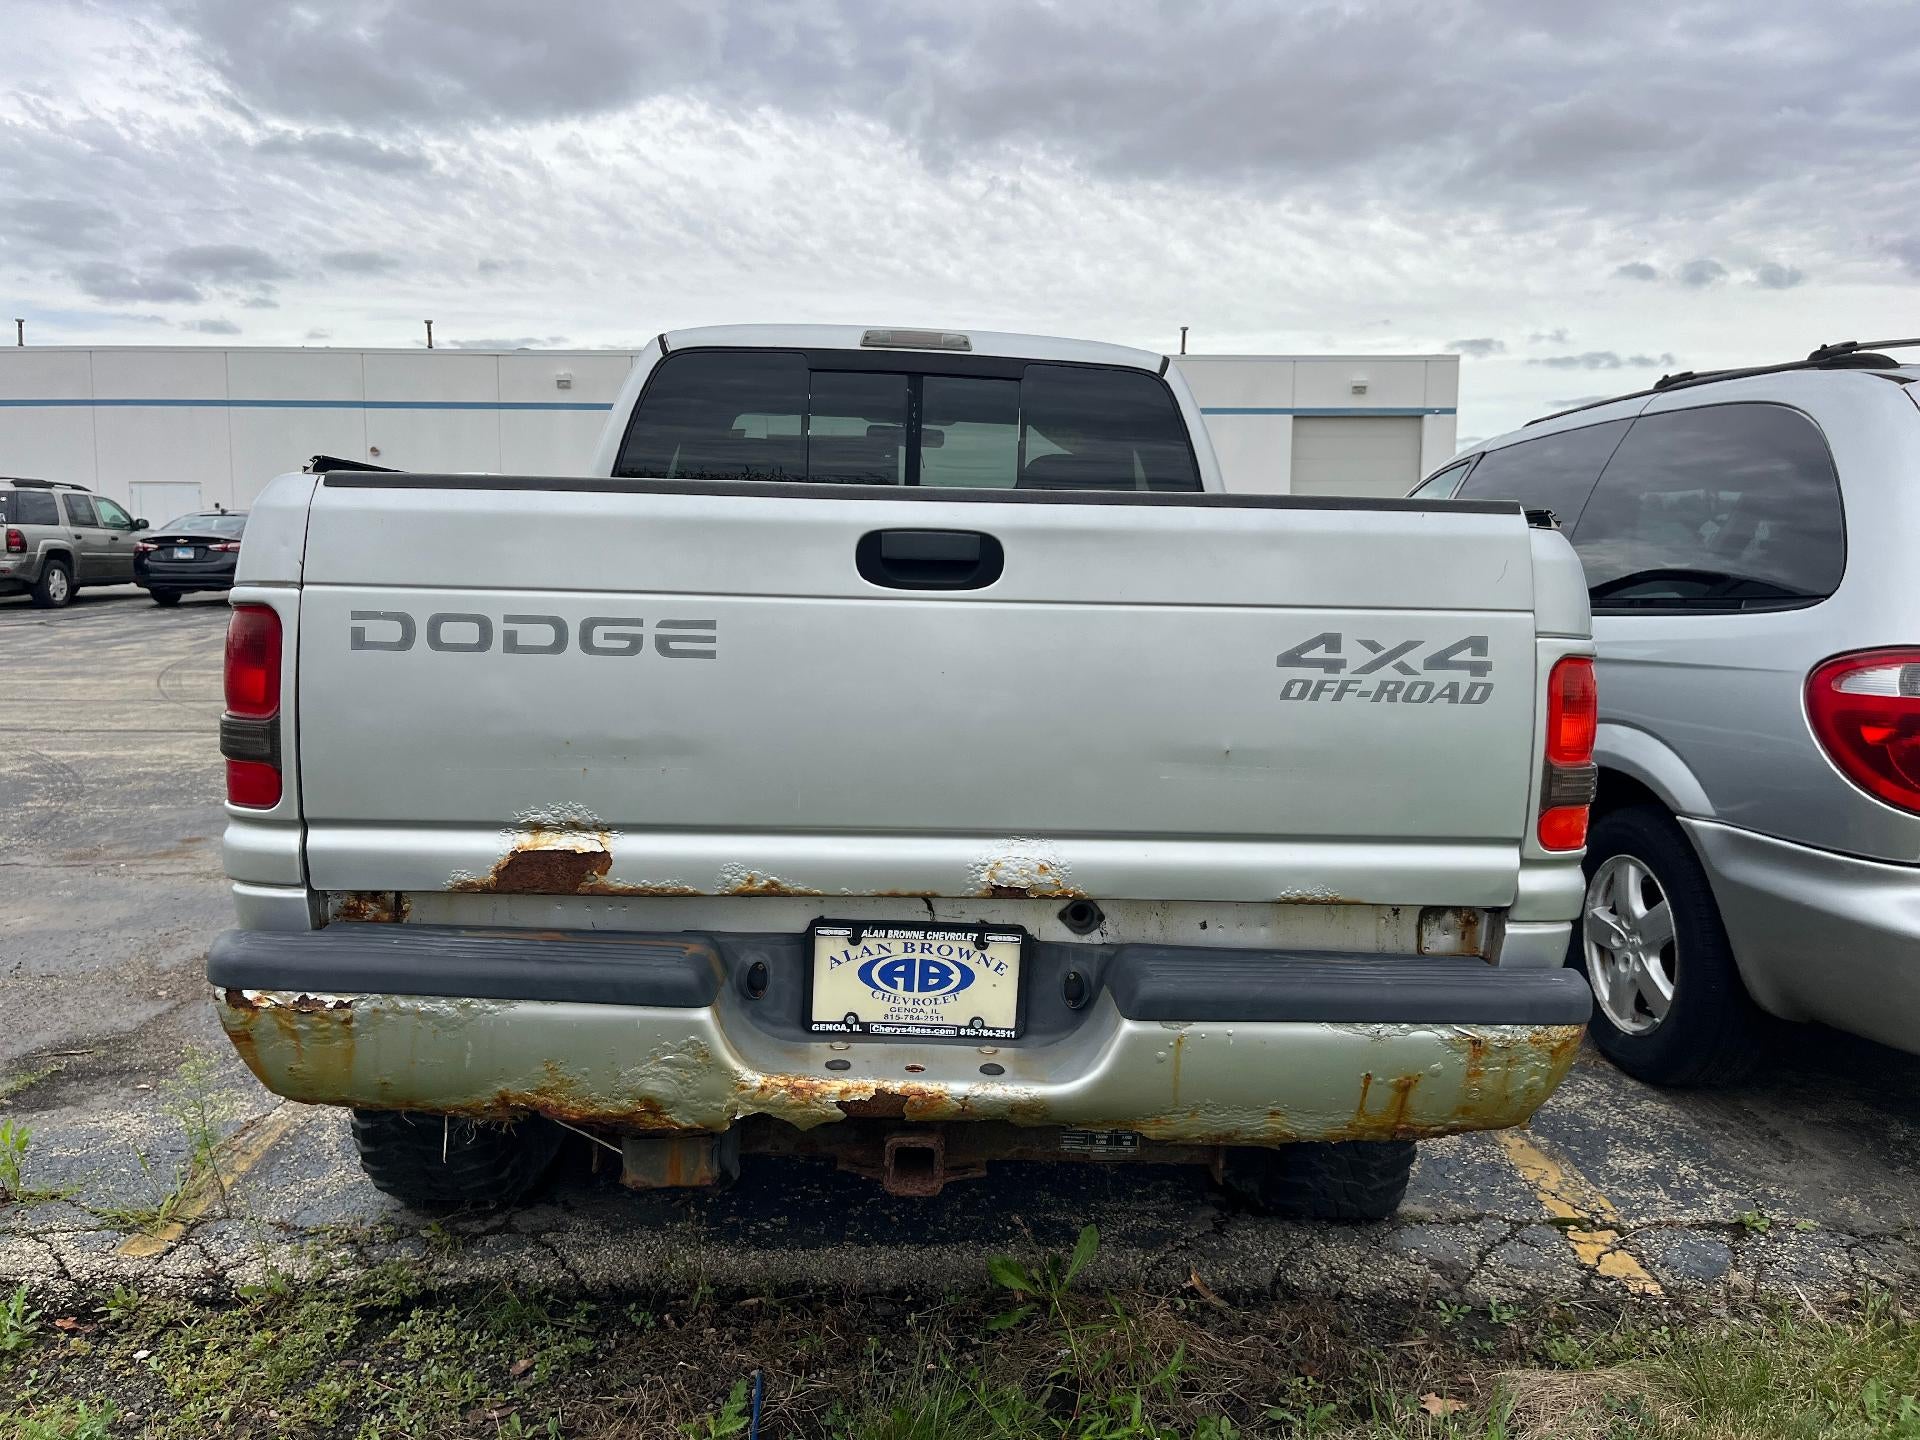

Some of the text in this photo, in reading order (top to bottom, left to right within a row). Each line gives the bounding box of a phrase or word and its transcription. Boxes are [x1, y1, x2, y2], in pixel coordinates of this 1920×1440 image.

[350, 610, 717, 660] DODGE
[1279, 678, 1495, 705] OFF-ROAD
[861, 928, 886, 939] ALAN
[887, 929, 925, 940] BROWNE
[926, 931, 979, 942] CHEVROLET
[829, 941, 1009, 977] ALAN BROWNE
[871, 989, 960, 1007] CHEVROLET
[889, 1006, 928, 1015] GENOA,
[883, 1013, 945, 1022] 815-784-2511
[811, 1023, 863, 1033] GENOA, IL
[871, 1024, 955, 1036] Chevys4less.com
[959, 1028, 1016, 1039] 815-784-2511
